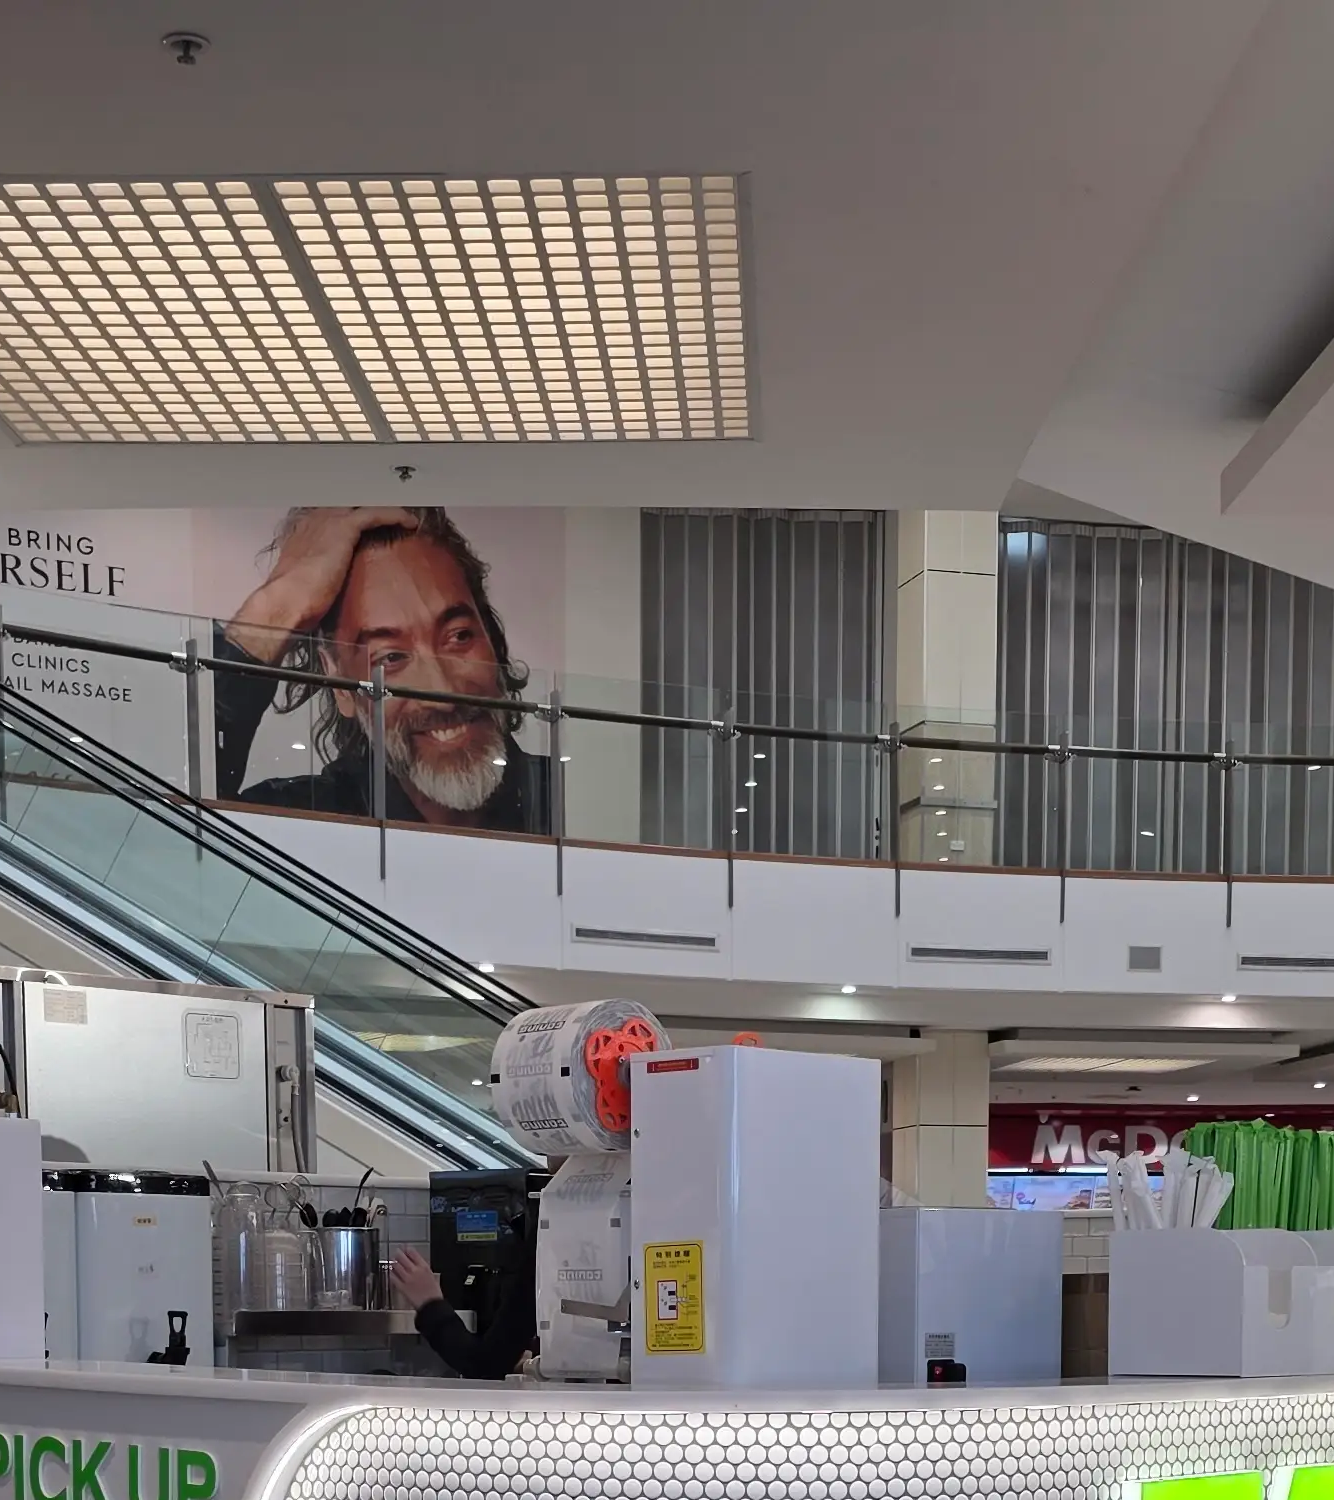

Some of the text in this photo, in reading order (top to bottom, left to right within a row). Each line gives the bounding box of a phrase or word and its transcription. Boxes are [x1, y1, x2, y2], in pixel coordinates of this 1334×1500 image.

[7, 527, 95, 555] BRING
[11, 653, 91, 674] CLINICS
[3, 675, 33, 692] AIL
[41, 678, 133, 702] MASSAGE
